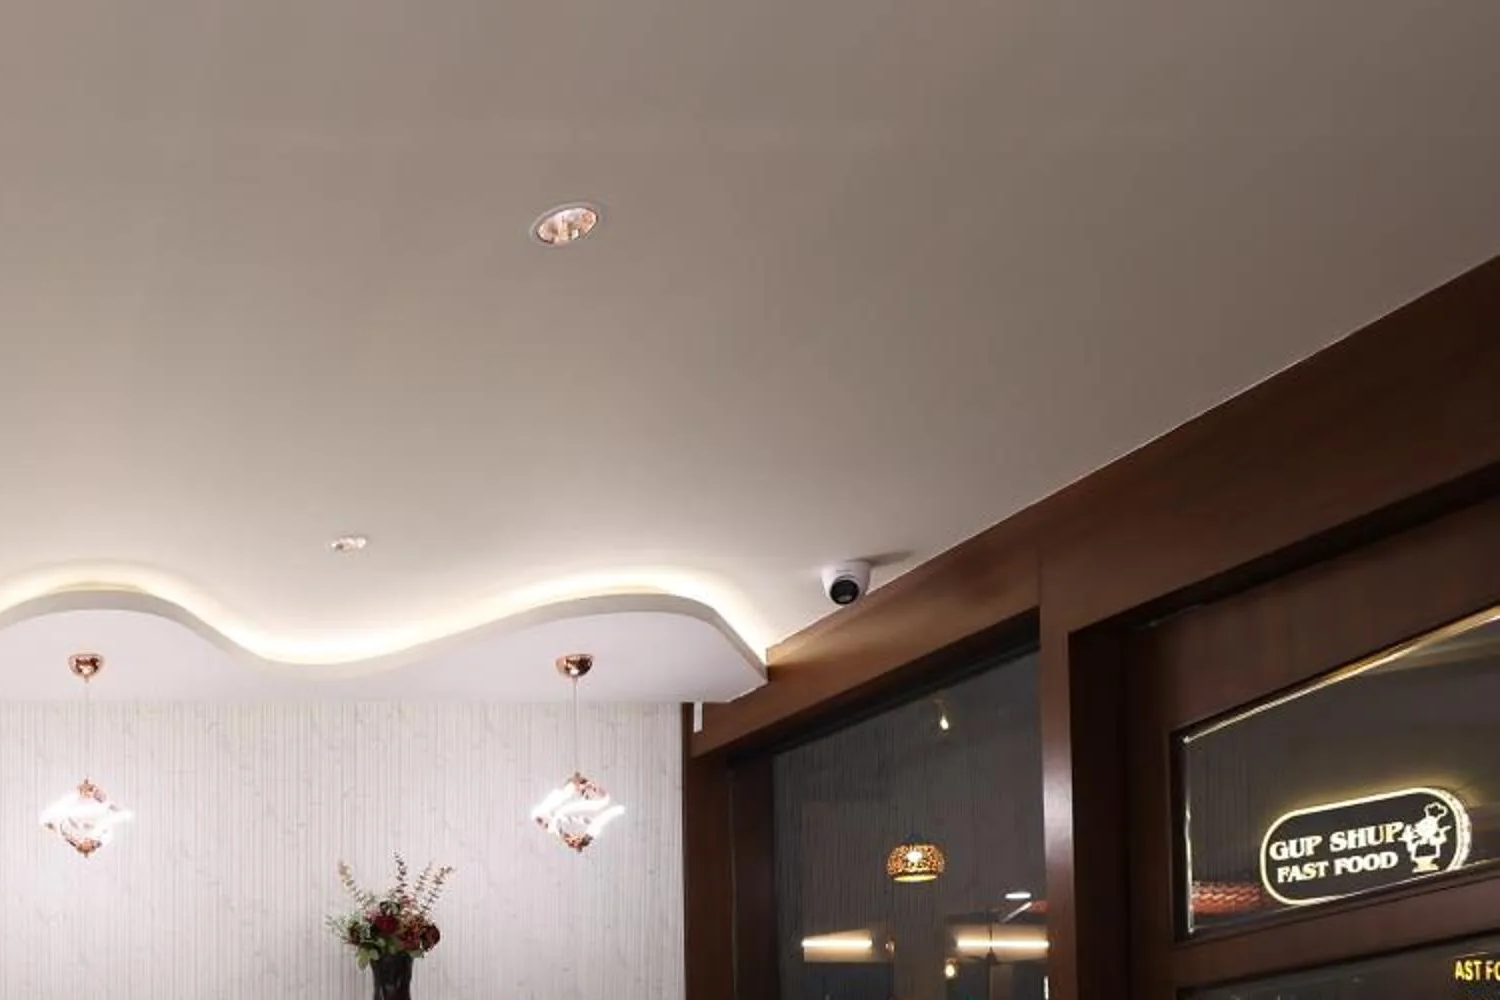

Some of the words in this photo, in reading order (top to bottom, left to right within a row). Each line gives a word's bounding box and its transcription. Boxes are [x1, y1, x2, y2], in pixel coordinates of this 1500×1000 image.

[1269, 835, 1323, 860] GUP
[1329, 821, 1405, 851] SHUP
[1277, 860, 1330, 884] FAST
[1334, 851, 1399, 876] FOOD
